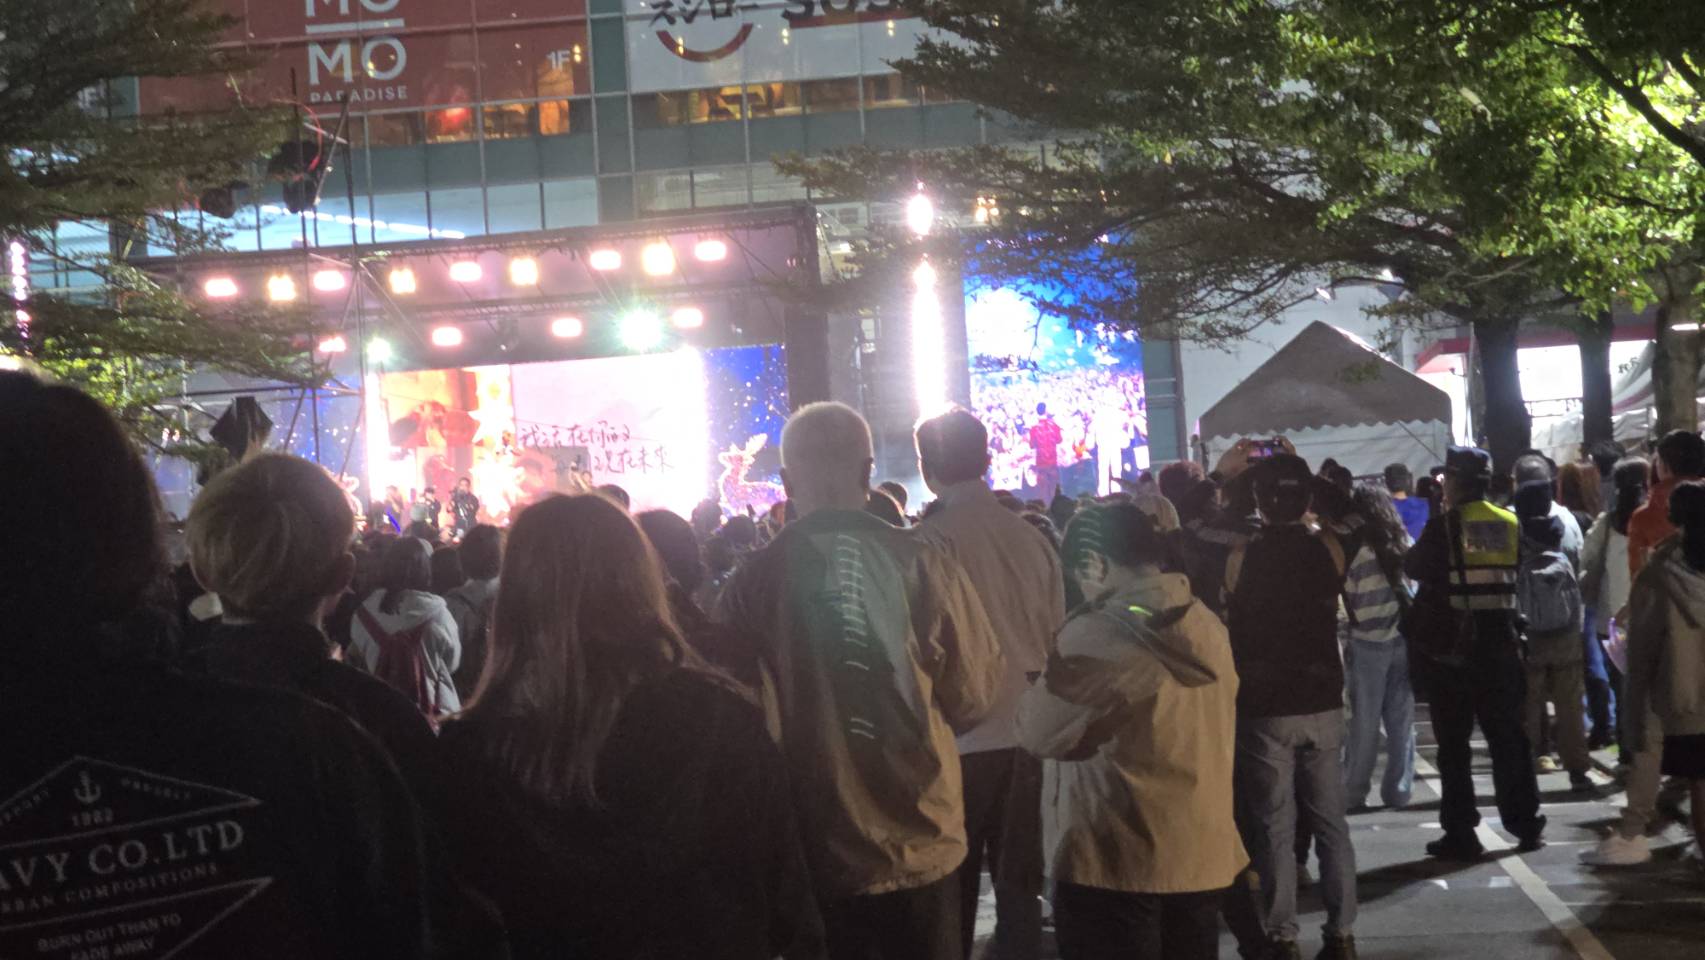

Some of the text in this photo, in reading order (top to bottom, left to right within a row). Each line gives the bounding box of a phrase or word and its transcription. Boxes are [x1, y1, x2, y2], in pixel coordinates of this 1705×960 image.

[308, 37, 407, 85] MO
[65, 862, 219, 903] COMPOSITIONS
[85, 931, 115, 943] OUT
[117, 922, 159, 937] THAN
